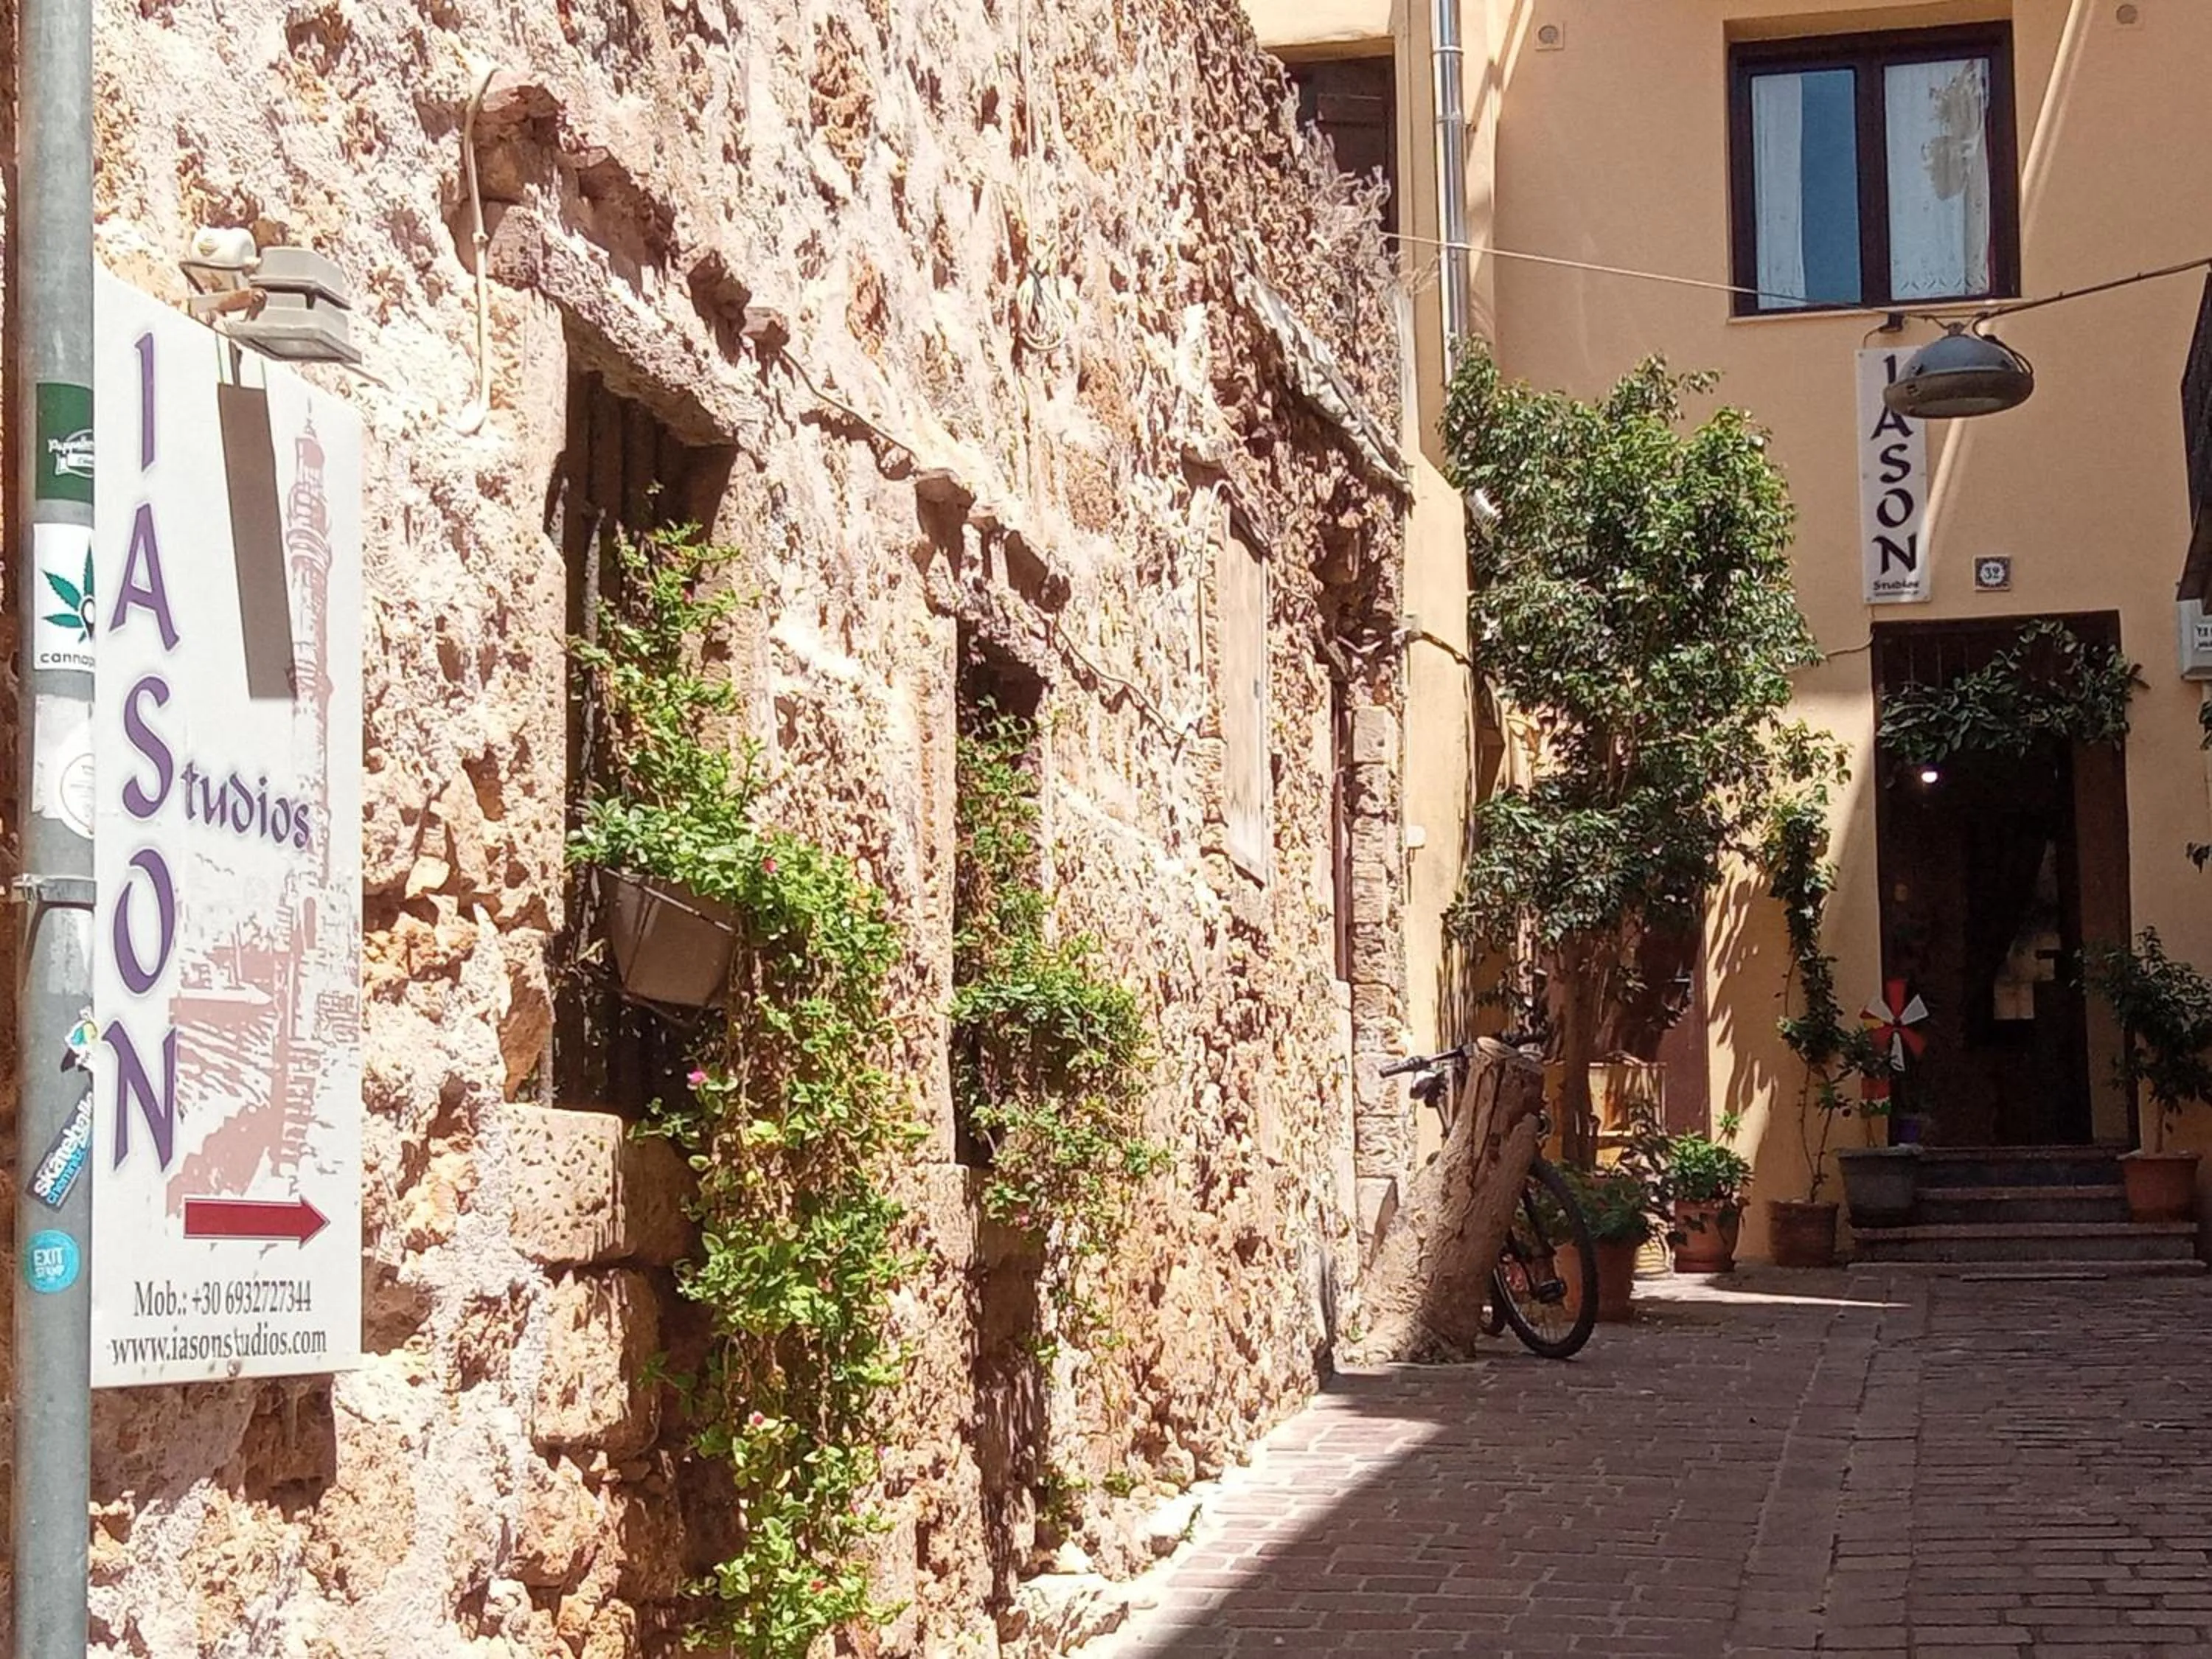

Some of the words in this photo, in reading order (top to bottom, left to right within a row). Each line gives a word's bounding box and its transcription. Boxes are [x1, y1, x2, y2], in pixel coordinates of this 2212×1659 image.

[1871, 354, 1919, 576] IASON
[102, 330, 180, 1172] IASON
[33, 1247, 63, 1266] EXIT
[133, 1280, 187, 1317] Mob.:
[192, 1281, 221, 1315] +30
[111, 1321, 327, 1366] www.iasonstudios.com
